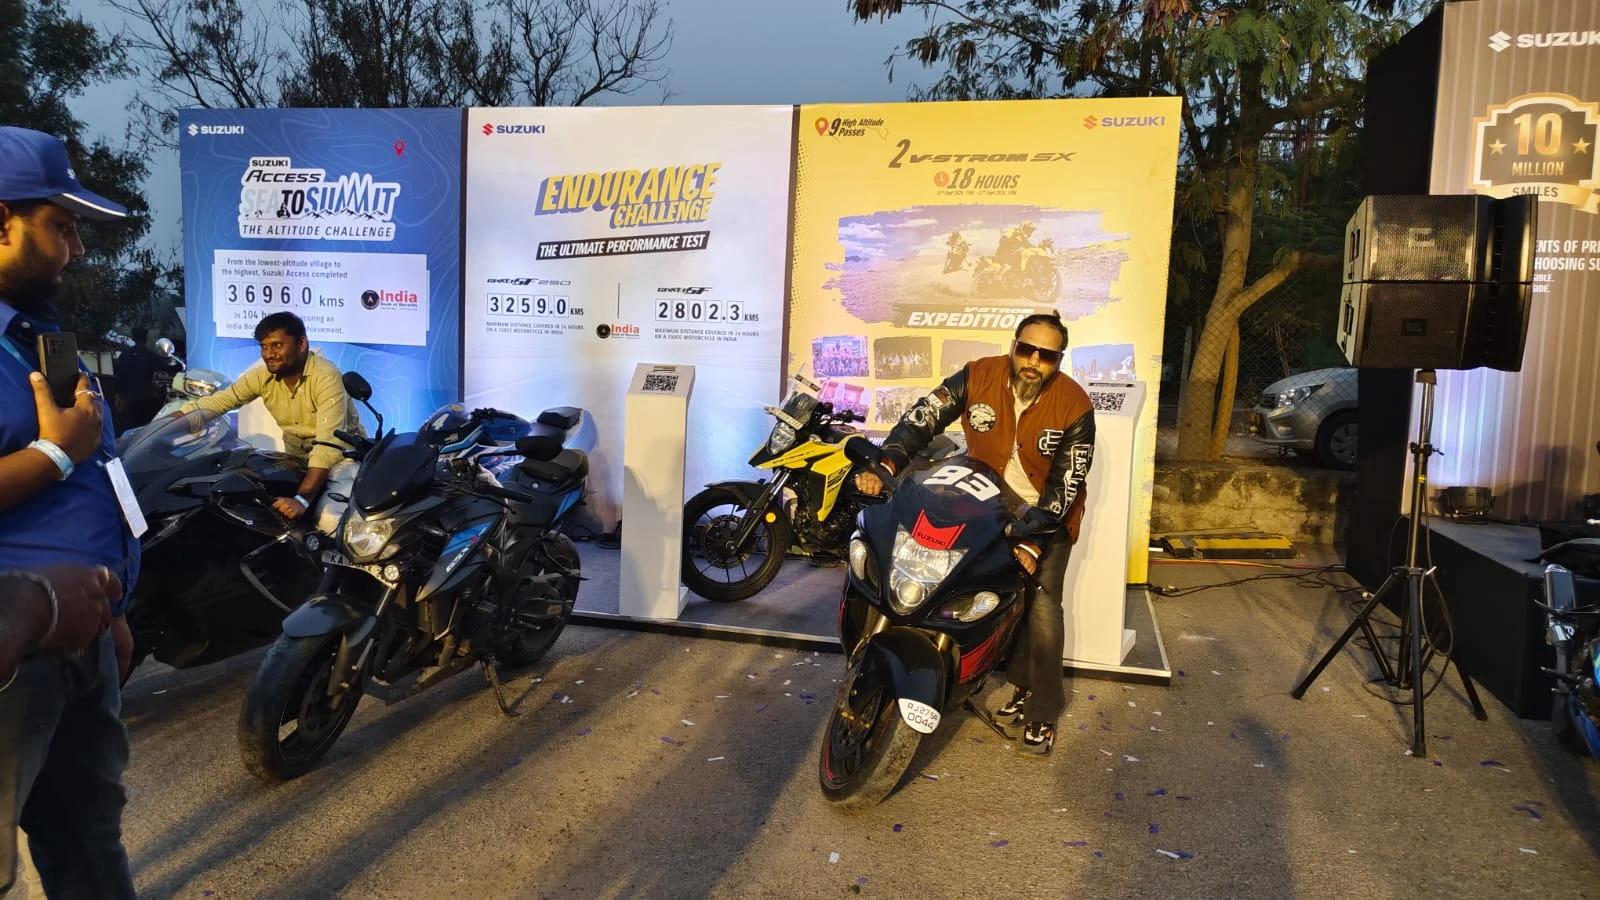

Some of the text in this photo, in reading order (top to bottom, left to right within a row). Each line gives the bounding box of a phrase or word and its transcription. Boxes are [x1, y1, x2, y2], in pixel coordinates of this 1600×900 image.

[1516, 31, 1600, 48] SUZUK
[828, 118, 842, 136] 9
[842, 117, 884, 128] High Altitude
[1101, 116, 1166, 128] SUZUKI
[200, 125, 245, 135] SUZUKI
[496, 124, 546, 134] SUZUKI
[839, 126, 866, 137] Passes
[1513, 112, 1563, 156] 10
[888, 139, 1077, 168] 2 V-STROM SX
[251, 159, 289, 168] SUZUKI
[1511, 161, 1565, 176] MILLION
[946, 167, 1021, 189] 18 HOURS
[534, 162, 722, 215] ENDURANCE
[1512, 186, 1560, 198] SMILES
[609, 198, 713, 229] CHALLENGE
[242, 224, 393, 237] THE ALTITUDE CHALLENGE
[539, 233, 706, 258] THE ULTIMATE PERFORMANCE TEST
[1563, 240, 1579, 253] OF
[245, 258, 256, 266] the
[257, 258, 308, 267] lowest-altitude
[309, 259, 333, 269] village
[334, 260, 341, 268] to
[1534, 257, 1585, 271] HOOSING
[234, 269, 261, 278] highest,
[262, 269, 285, 277] Suzuki
[285, 270, 310, 278] Access
[311, 270, 348, 279] completed
[319, 295, 345, 307] kms
[380, 289, 418, 303] India
[234, 311, 241, 319] in
[243, 310, 258, 319] 104
[570, 308, 584, 316] KMS
[744, 313, 760, 322] KMS
[611, 323, 640, 334] India
[1075, 450, 1088, 476] EASY
[922, 465, 1001, 502] 93
[917, 531, 947, 546] SUZUKI
[330, 552, 343, 564] KA
[907, 712, 934, 729] 0044
